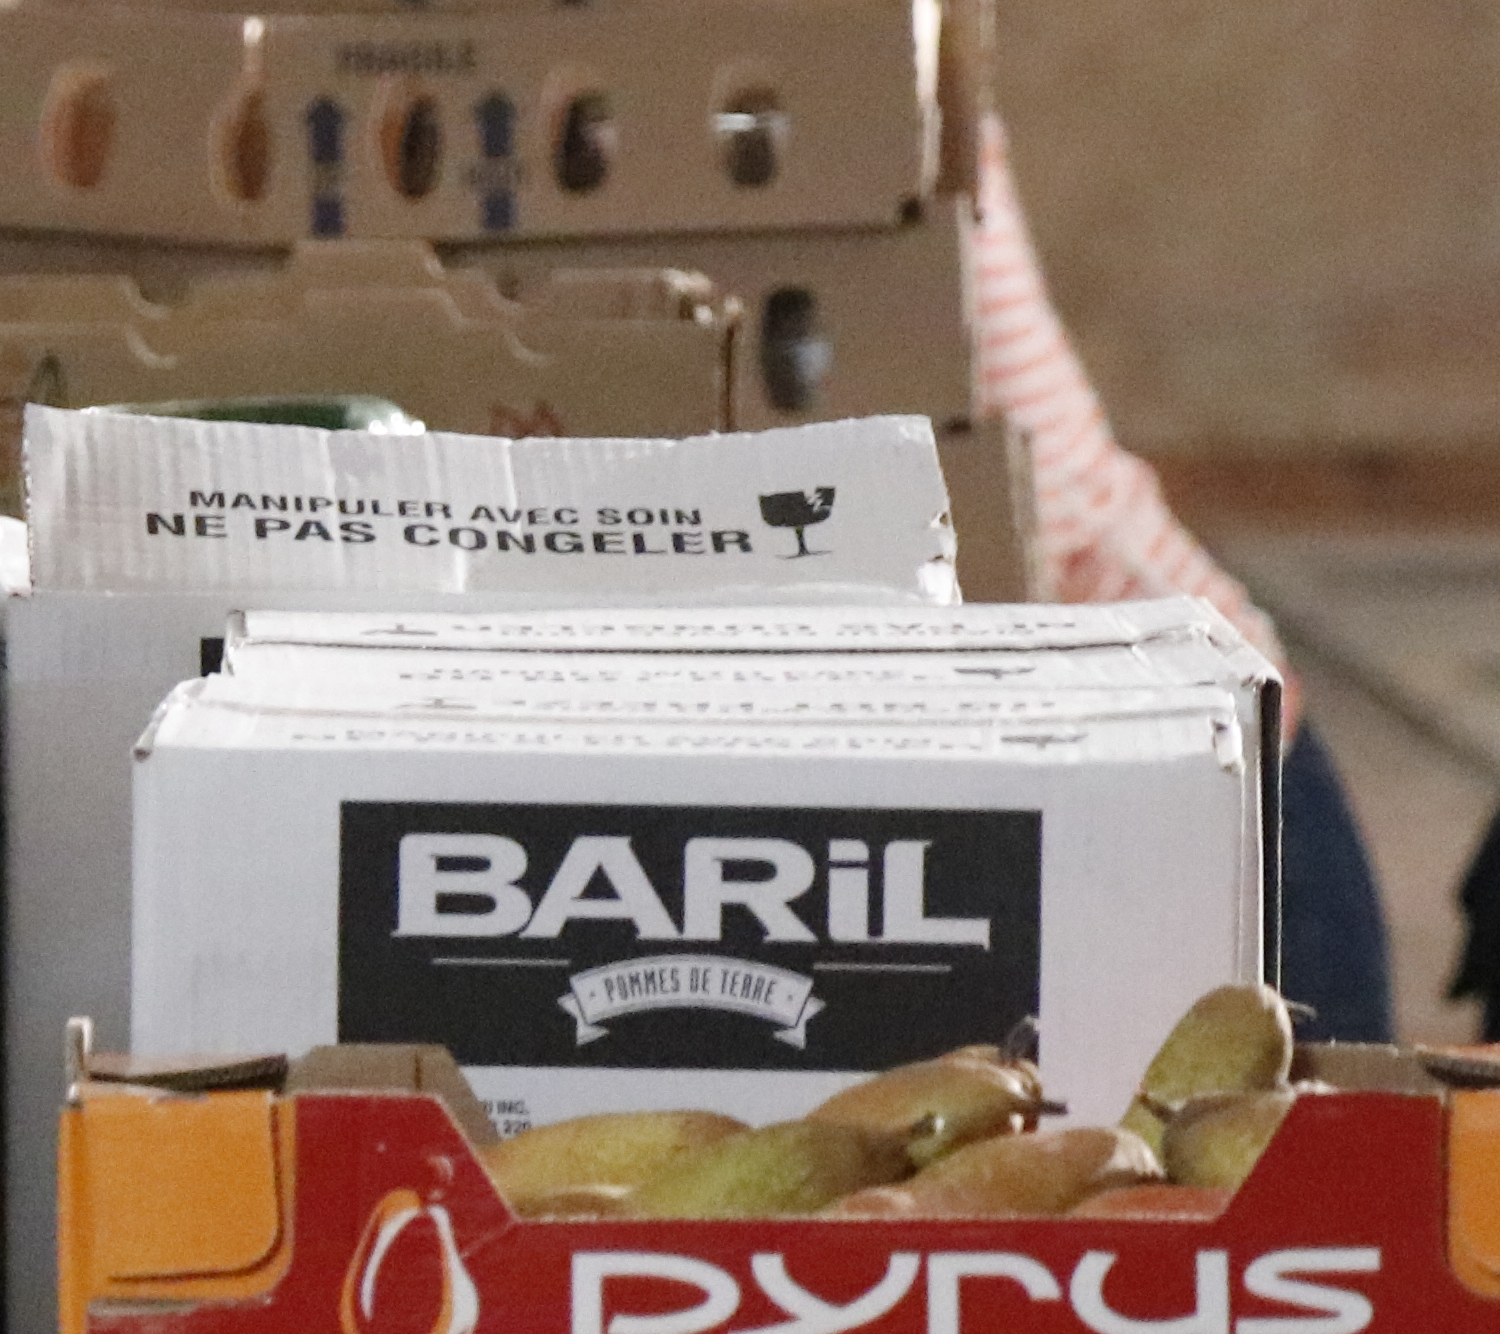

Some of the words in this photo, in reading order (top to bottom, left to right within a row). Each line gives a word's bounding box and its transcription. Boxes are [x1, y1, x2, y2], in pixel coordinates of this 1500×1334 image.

[188, 490, 452, 521] MANIPULER
[471, 504, 580, 525] AVEC
[597, 507, 702, 526] SOIN
[145, 513, 228, 539] NE
[255, 515, 377, 544] PAS
[403, 524, 754, 555] CONGELER
[604, 968, 680, 1004] POMMES
[690, 967, 710, 995] DE
[721, 969, 778, 1004] TERRE
